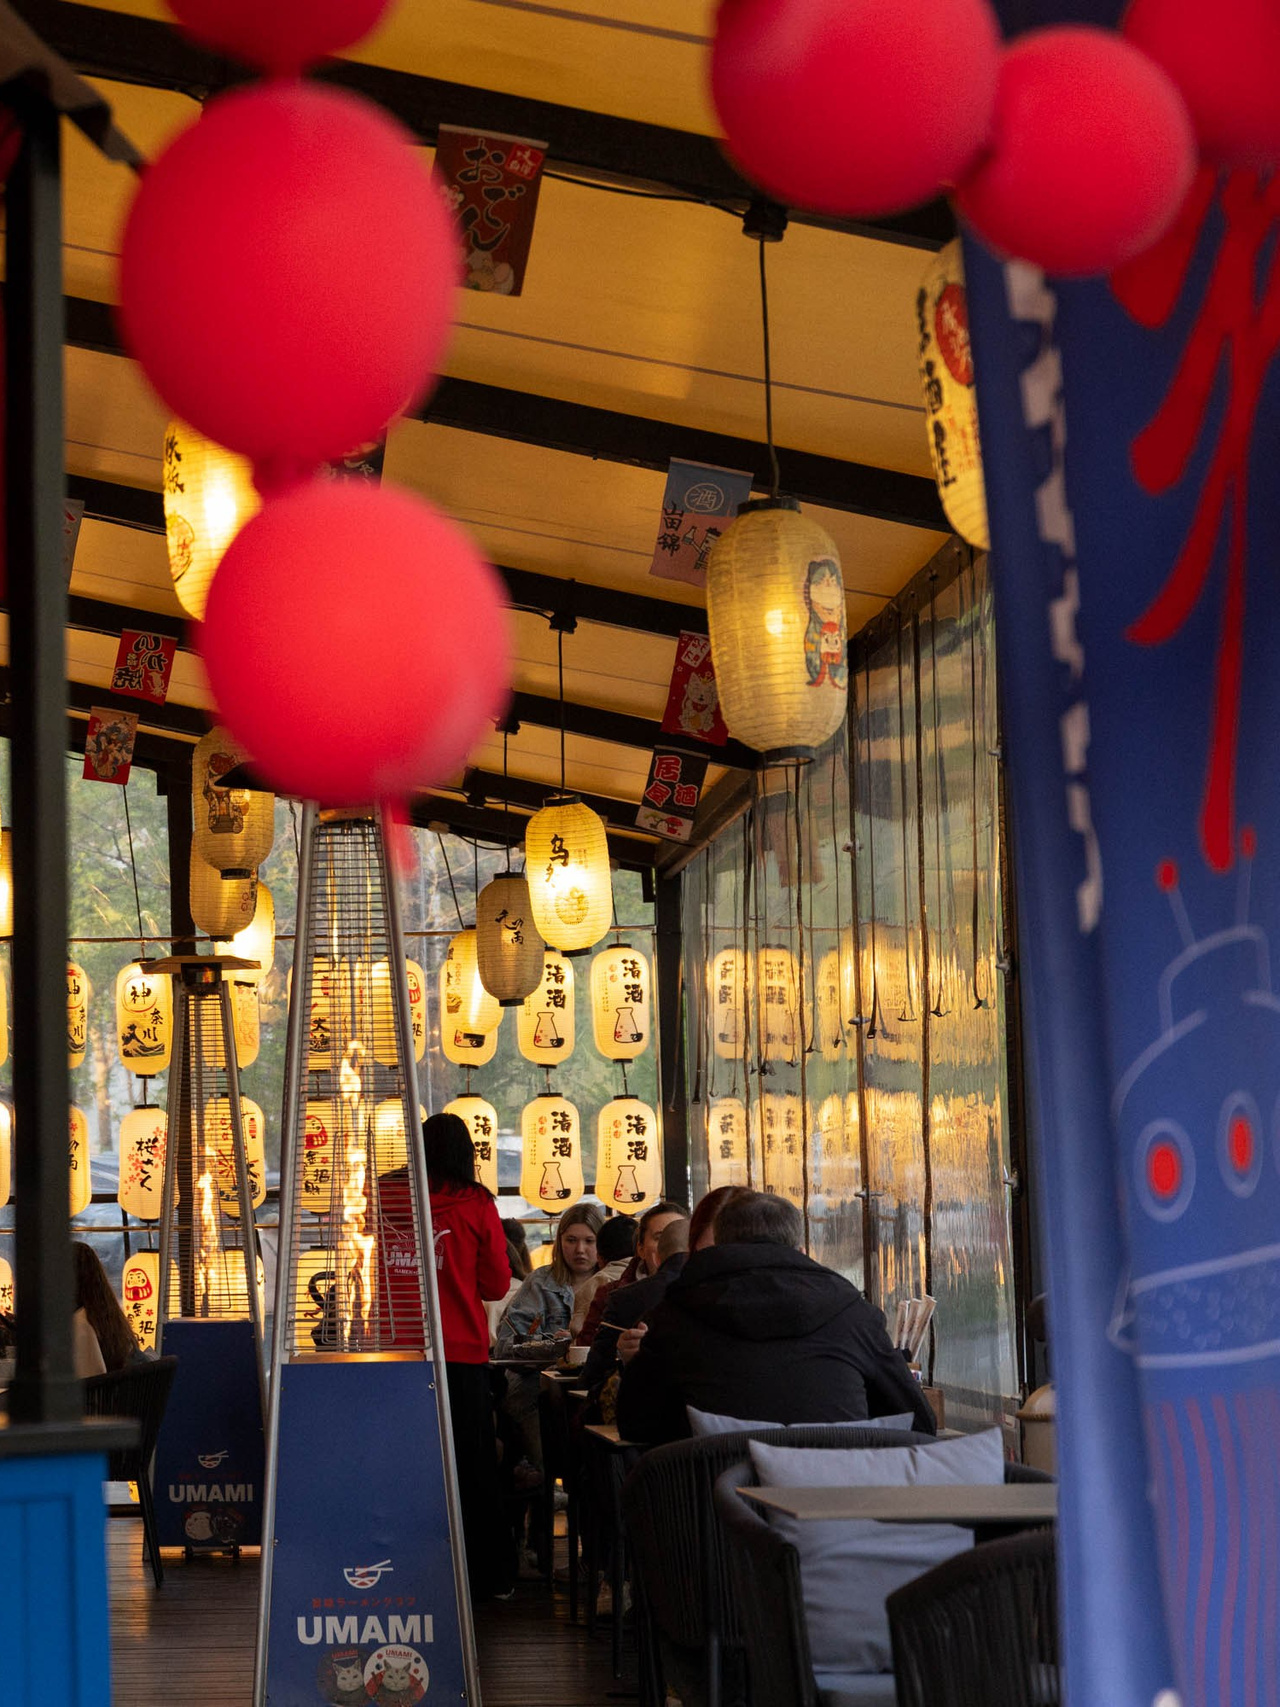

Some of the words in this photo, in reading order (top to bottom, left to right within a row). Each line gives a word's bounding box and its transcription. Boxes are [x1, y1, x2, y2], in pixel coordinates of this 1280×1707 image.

[657, 501, 684, 557] 山田錦
[130, 982, 164, 1043] 神奈川
[135, 1136, 159, 1192] 桜さく
[385, 1251, 444, 1270] UMAI
[168, 1484, 254, 1503] UMAMI
[297, 1614, 434, 1645] UMAMI
